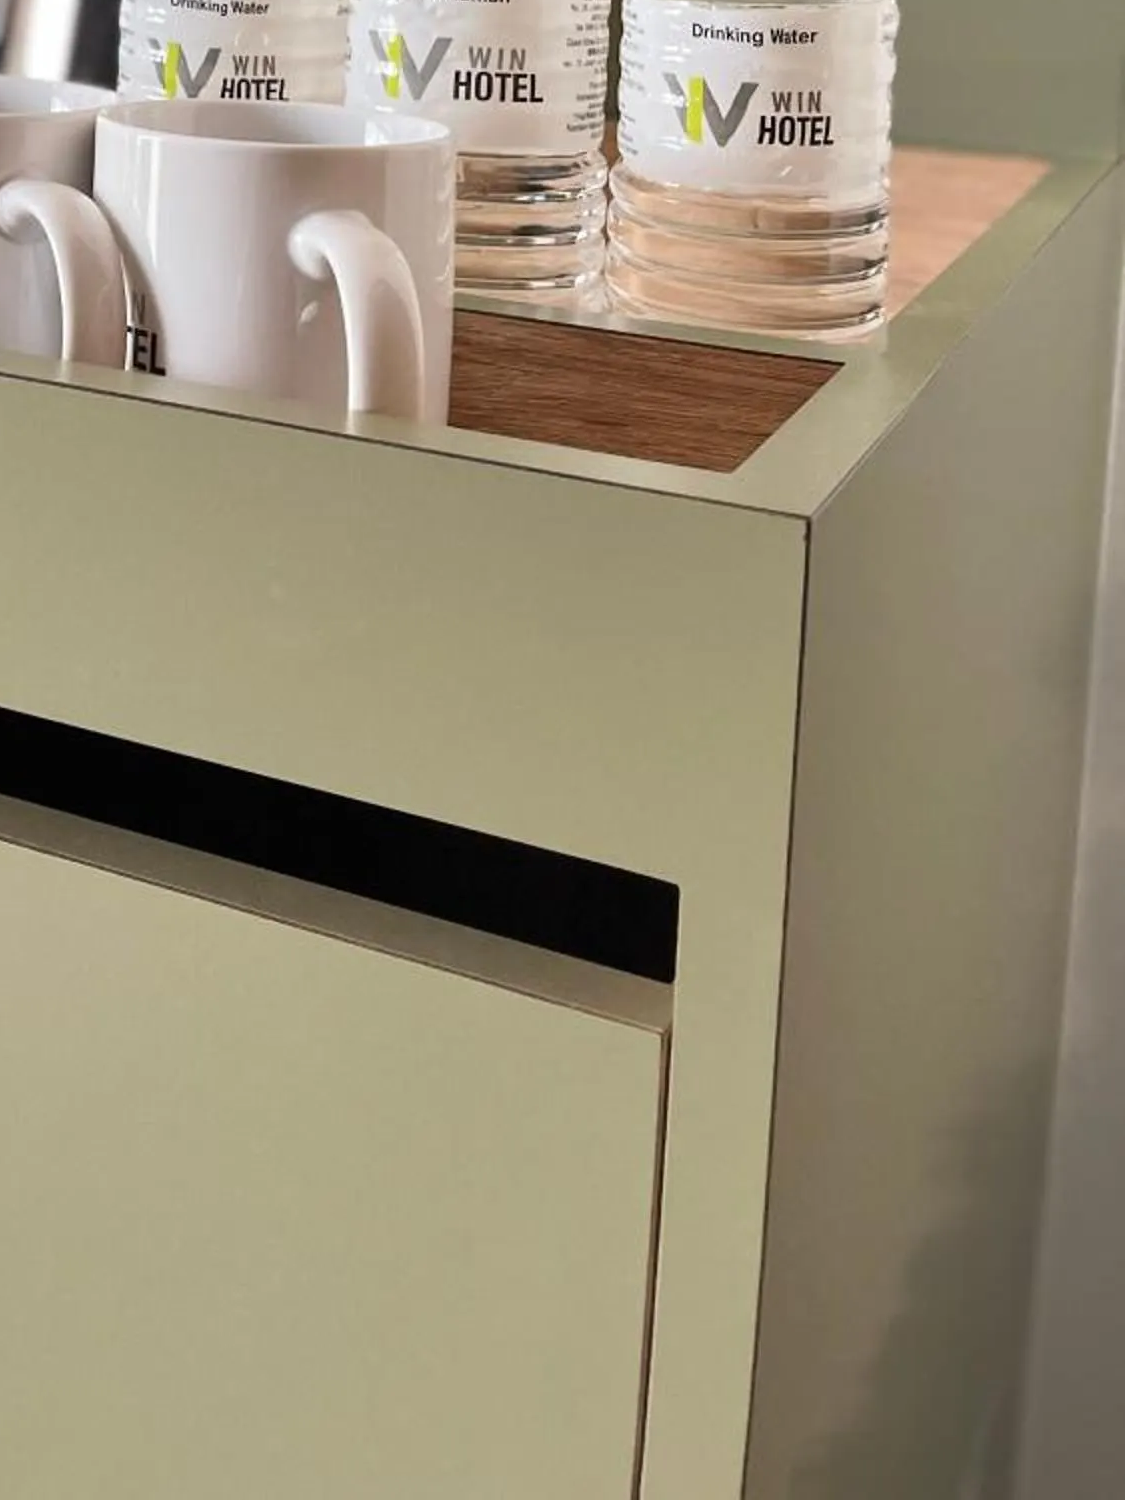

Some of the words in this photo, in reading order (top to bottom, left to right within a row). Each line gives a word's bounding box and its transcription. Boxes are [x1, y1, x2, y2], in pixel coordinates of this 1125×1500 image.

[231, 0, 270, 15] Water
[692, 23, 764, 47] Drinking
[770, 28, 818, 44] Water
[232, 55, 276, 76] WIN
[469, 46, 526, 70] WIN
[220, 78, 290, 101] HOTEL
[452, 71, 544, 103] HOTEL
[772, 90, 822, 112] WIN
[757, 116, 835, 146] HOTEL
